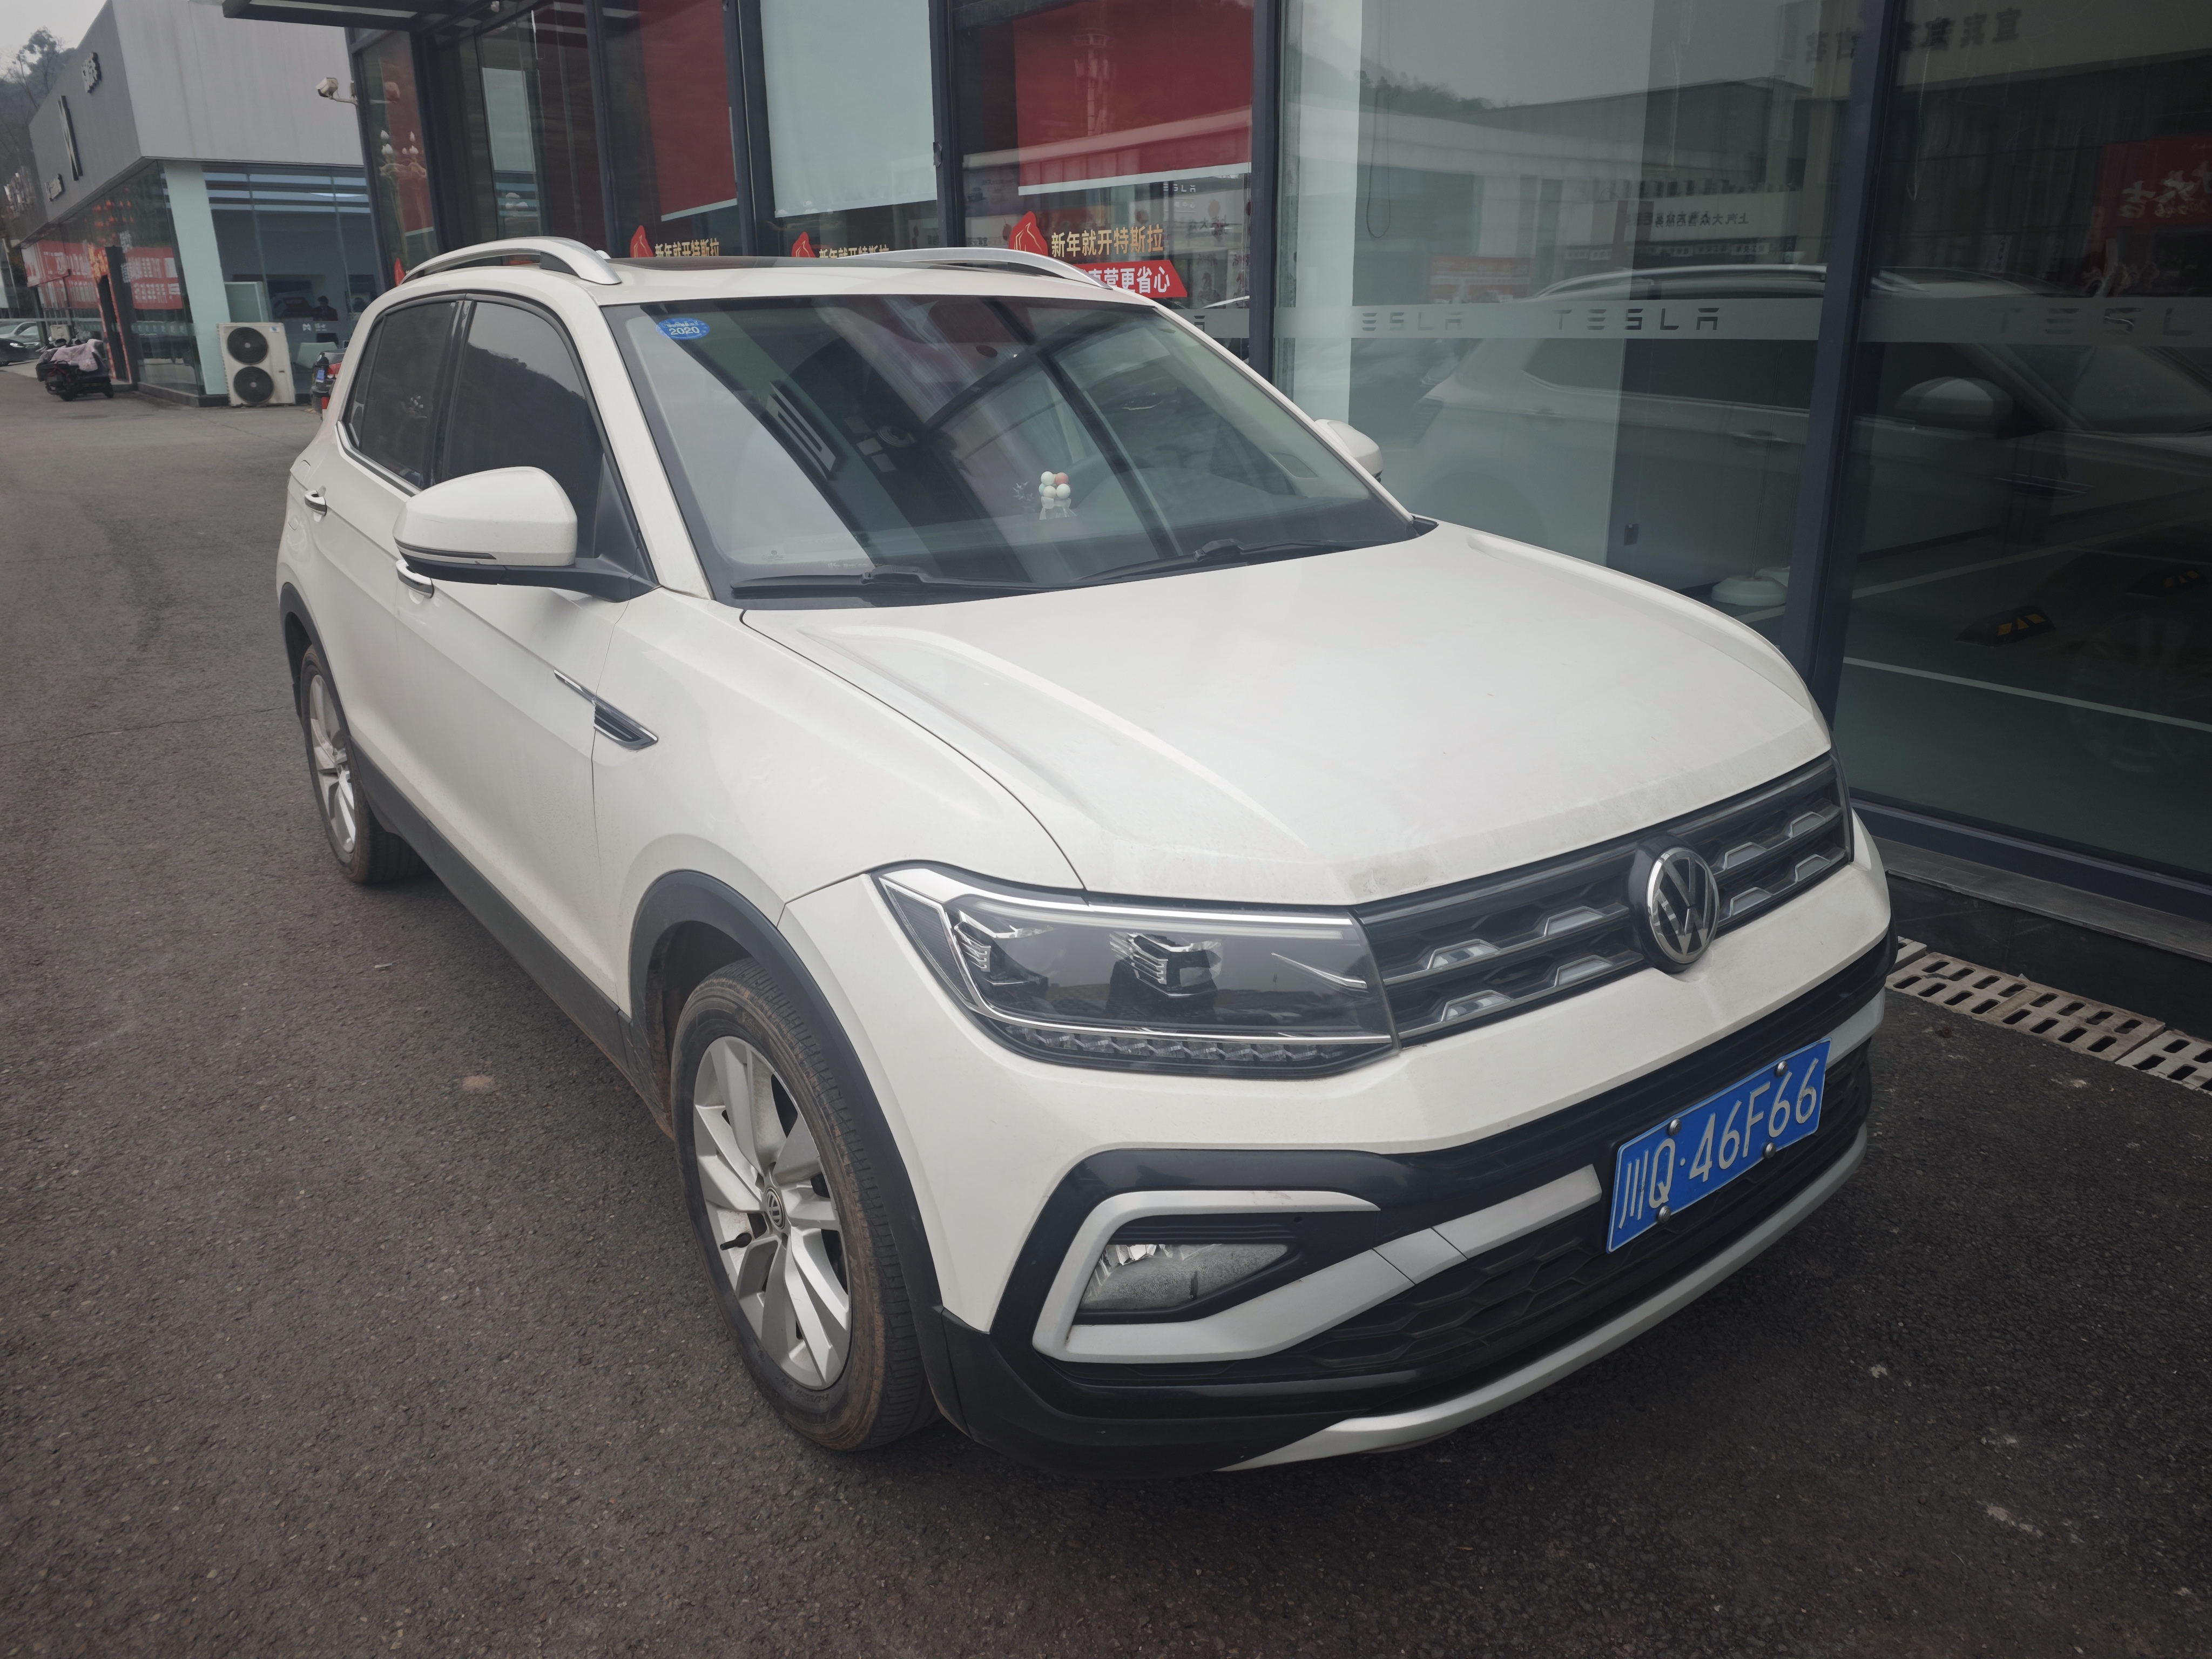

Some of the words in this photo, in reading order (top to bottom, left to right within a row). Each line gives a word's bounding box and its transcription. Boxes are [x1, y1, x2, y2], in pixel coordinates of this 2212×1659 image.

[1051, 224, 1164, 257] 新年就开特斯拉
[669, 326, 700, 335] 2020
[1553, 307, 1719, 331] TESLA
